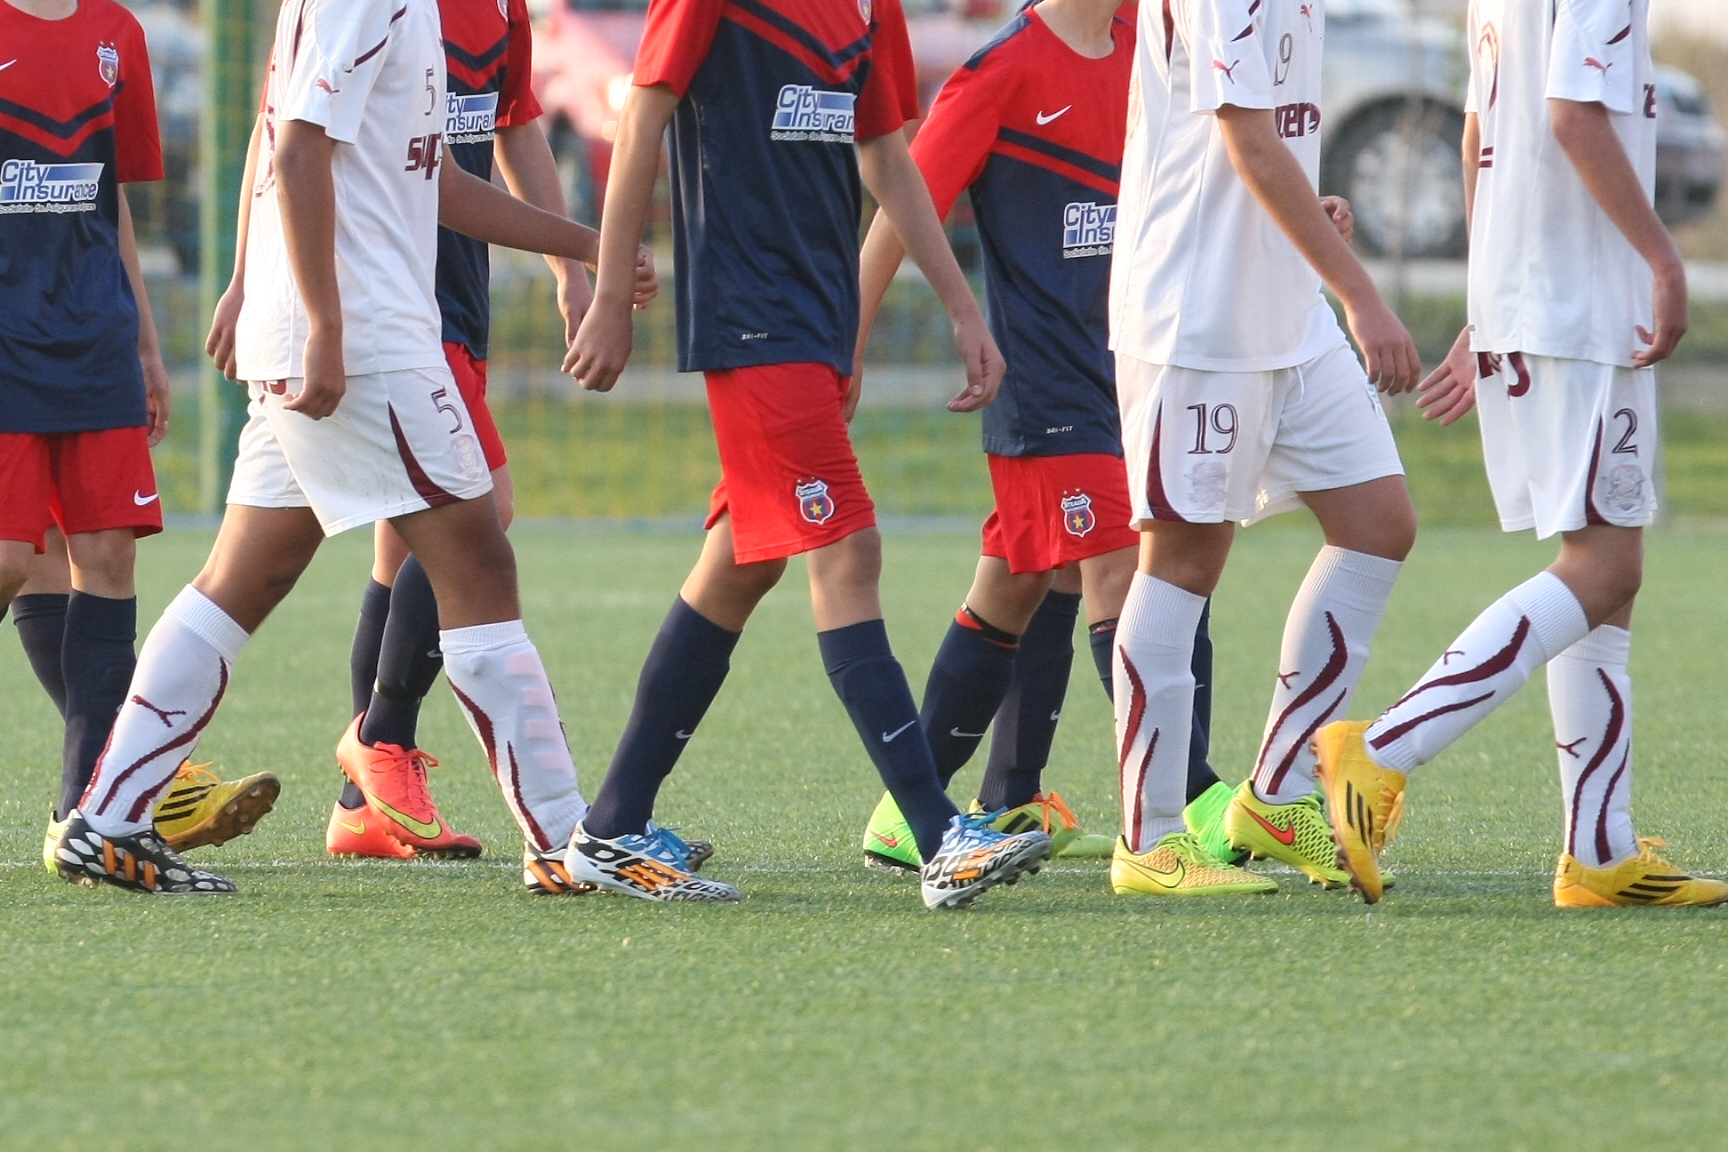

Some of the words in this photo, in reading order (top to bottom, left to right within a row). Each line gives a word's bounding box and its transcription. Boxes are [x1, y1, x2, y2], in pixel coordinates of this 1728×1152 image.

[424, 64, 437, 116] 5
[778, 86, 821, 114] City
[446, 94, 466, 118] ty
[445, 113, 494, 131] nsura
[1, 161, 50, 188] City
[15, 182, 97, 200] Insurance
[1066, 204, 1109, 229] City
[430, 385, 464, 434] 5
[1187, 403, 1239, 454] 19
[1611, 408, 1638, 457] 2
